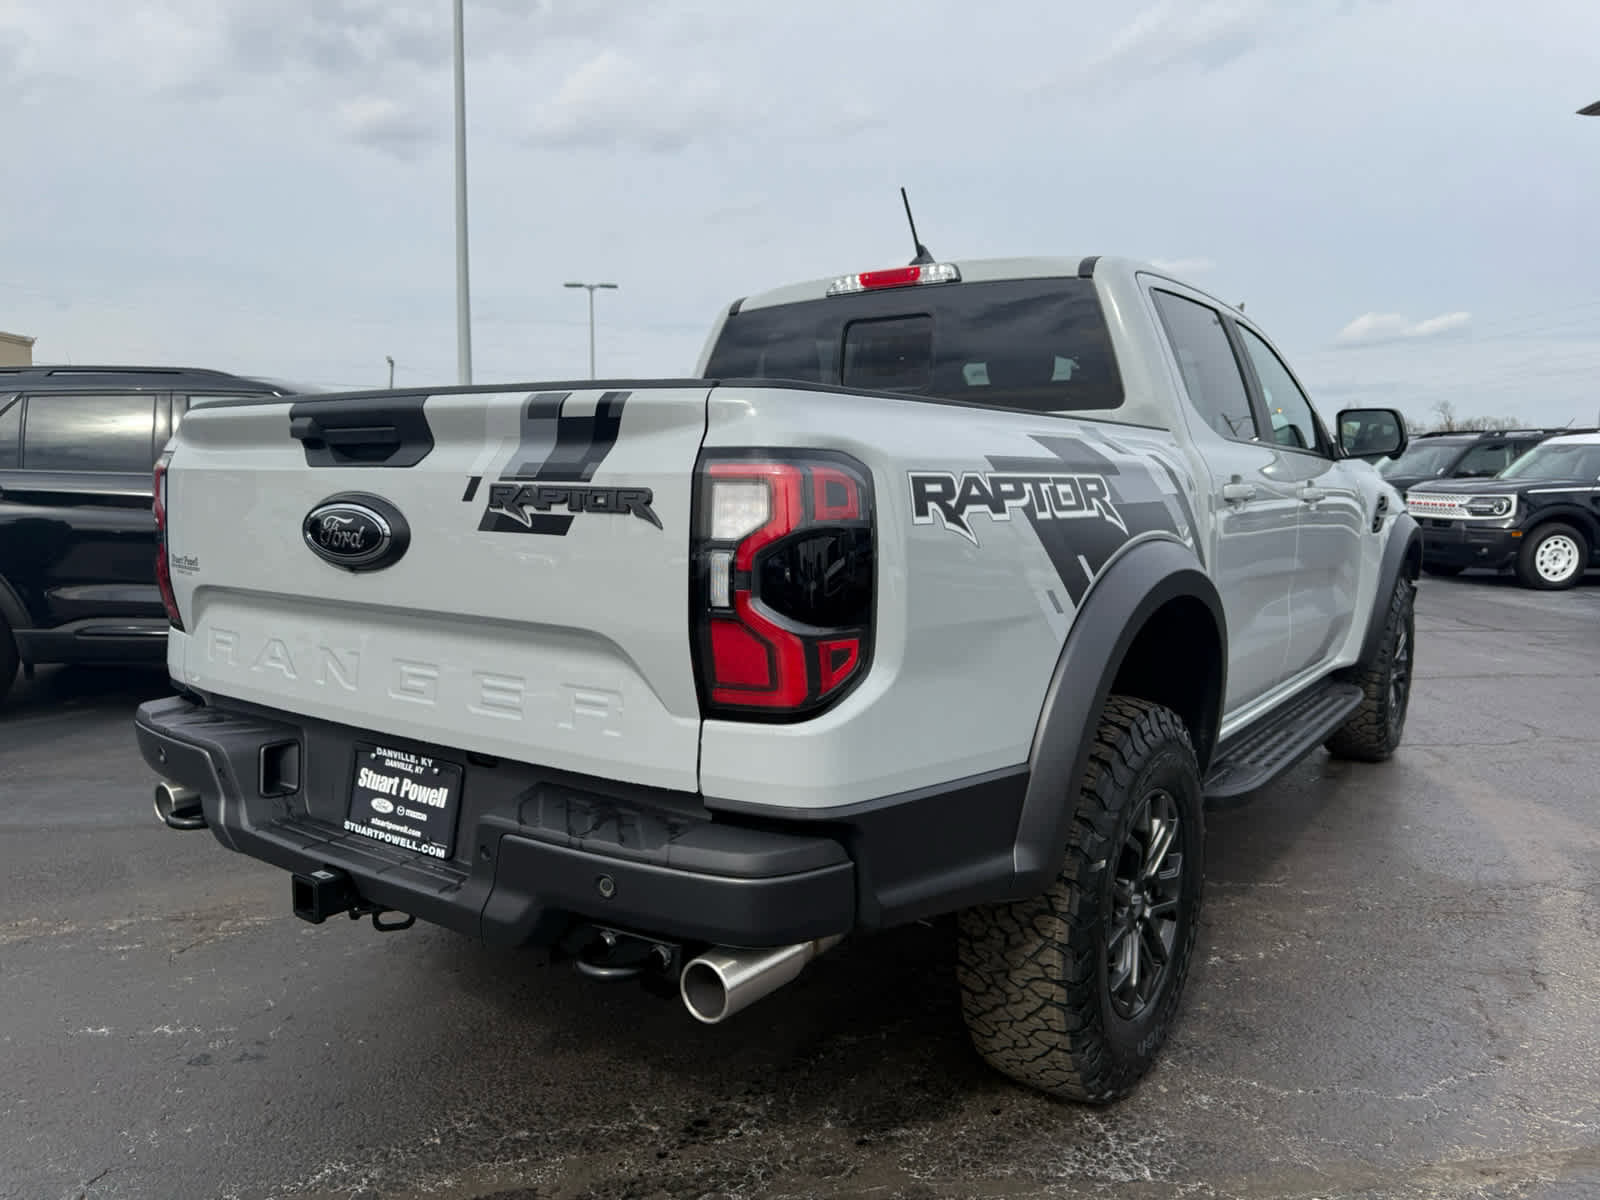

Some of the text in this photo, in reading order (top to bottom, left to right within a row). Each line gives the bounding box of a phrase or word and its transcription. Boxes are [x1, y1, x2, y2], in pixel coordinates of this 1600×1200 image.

[489, 484, 663, 530] RAPTOR
[908, 471, 1129, 547] RAPTOR
[321, 515, 365, 548] Ford
[208, 626, 624, 737] RANGER
[376, 747, 433, 767] DANVILLE, KY
[385, 759, 424, 774] DANVILLE, KY
[358, 767, 448, 808] Stuart Powell
[344, 821, 445, 858] STUARTPOWELL.COM
